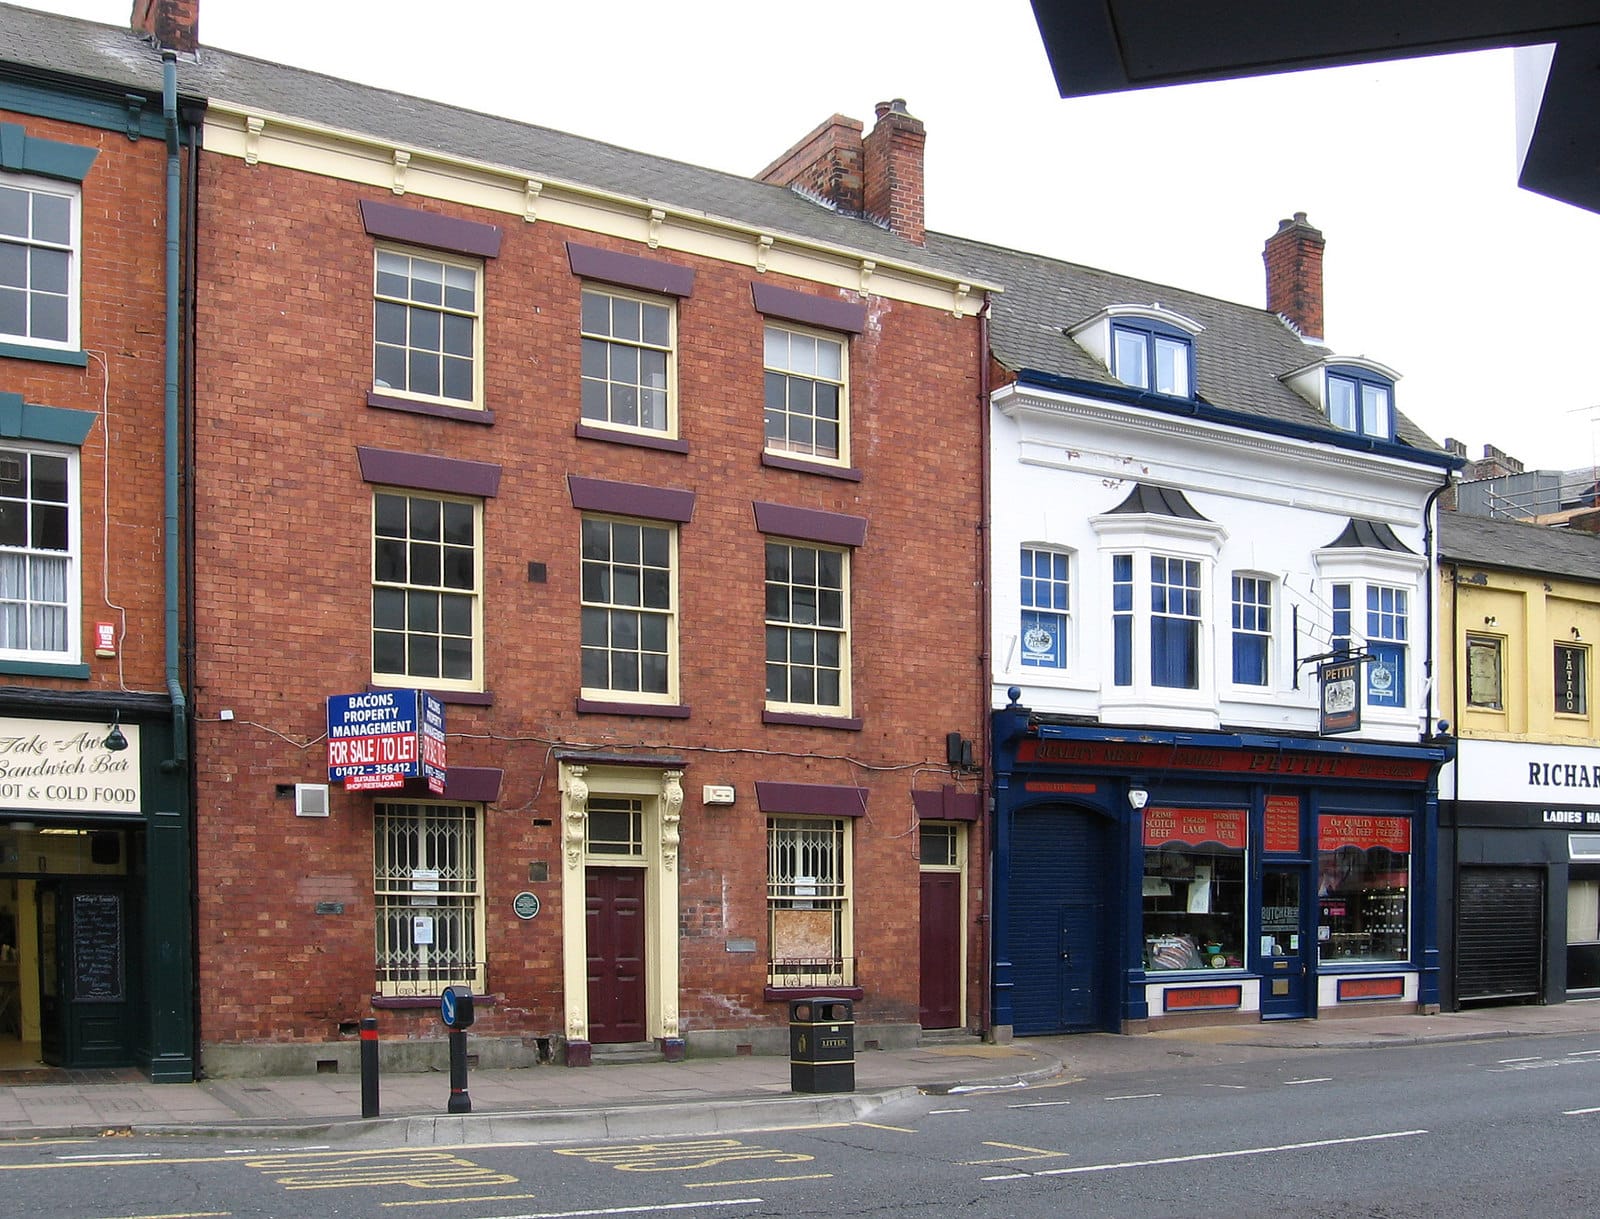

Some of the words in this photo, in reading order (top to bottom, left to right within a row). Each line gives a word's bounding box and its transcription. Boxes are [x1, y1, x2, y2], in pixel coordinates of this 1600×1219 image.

[1326, 666, 1355, 681] PETTIT
[1566, 650, 1574, 711] TATTOO
[349, 693, 394, 709] BACONS
[344, 707, 399, 723] PROPERTY
[333, 720, 412, 738] MANAGEMENT
[0, 734, 49, 754] Take
[330, 741, 348, 765] FOR
[350, 738, 375, 764] SALE
[382, 737, 396, 761] TO
[397, 735, 415, 760] LET
[0, 756, 85, 778] Sandwich
[90, 753, 129, 773] Bar
[335, 765, 365, 777] 01472
[375, 762, 411, 774] 356412
[1251, 753, 1341, 773] PETTIT
[381, 773, 395, 781] FOR
[0, 783, 22, 798] OT
[28, 786, 40, 799] &
[46, 785, 89, 800] COLD
[94, 786, 137, 802] FOOD
[1151, 810, 1174, 819] PRIME
[1344, 817, 1372, 827] QUALITY
[1543, 810, 1583, 823] LADIES
[1145, 819, 1176, 829] SCOTCH
[1183, 825, 1206, 834] LAMB
[1216, 822, 1237, 830] PORK
[1150, 829, 1172, 838] BEEF
[1216, 830, 1237, 839] VEAL
[821, 1039, 847, 1047] LITTER
